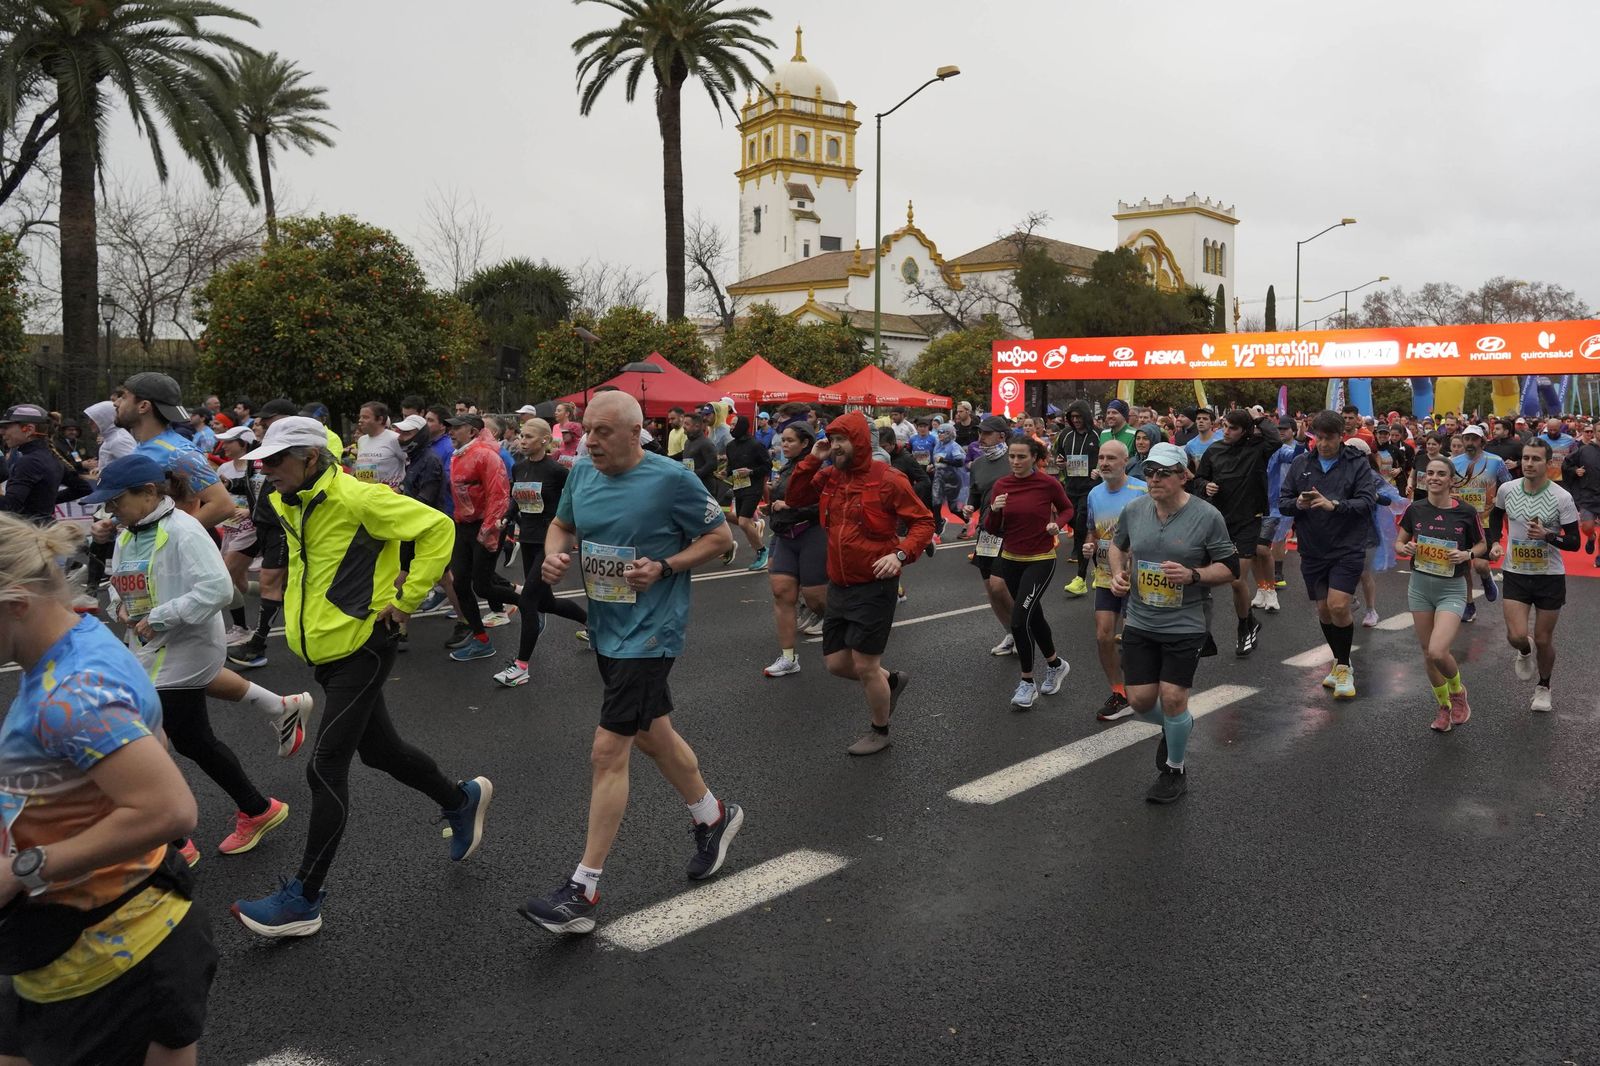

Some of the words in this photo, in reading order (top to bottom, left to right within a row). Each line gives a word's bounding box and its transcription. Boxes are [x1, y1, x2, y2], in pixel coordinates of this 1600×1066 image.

[1252, 340, 1318, 355] maratón
[1406, 341, 1460, 359] HOKA
[1070, 354, 1106, 364] Sprinter
[1144, 350, 1186, 365] HOKA
[1266, 351, 1319, 367] sevilla
[1470, 352, 1512, 361] HYUNDAI
[1514, 547, 1543, 559] 16838
[585, 556, 626, 578] 20528
